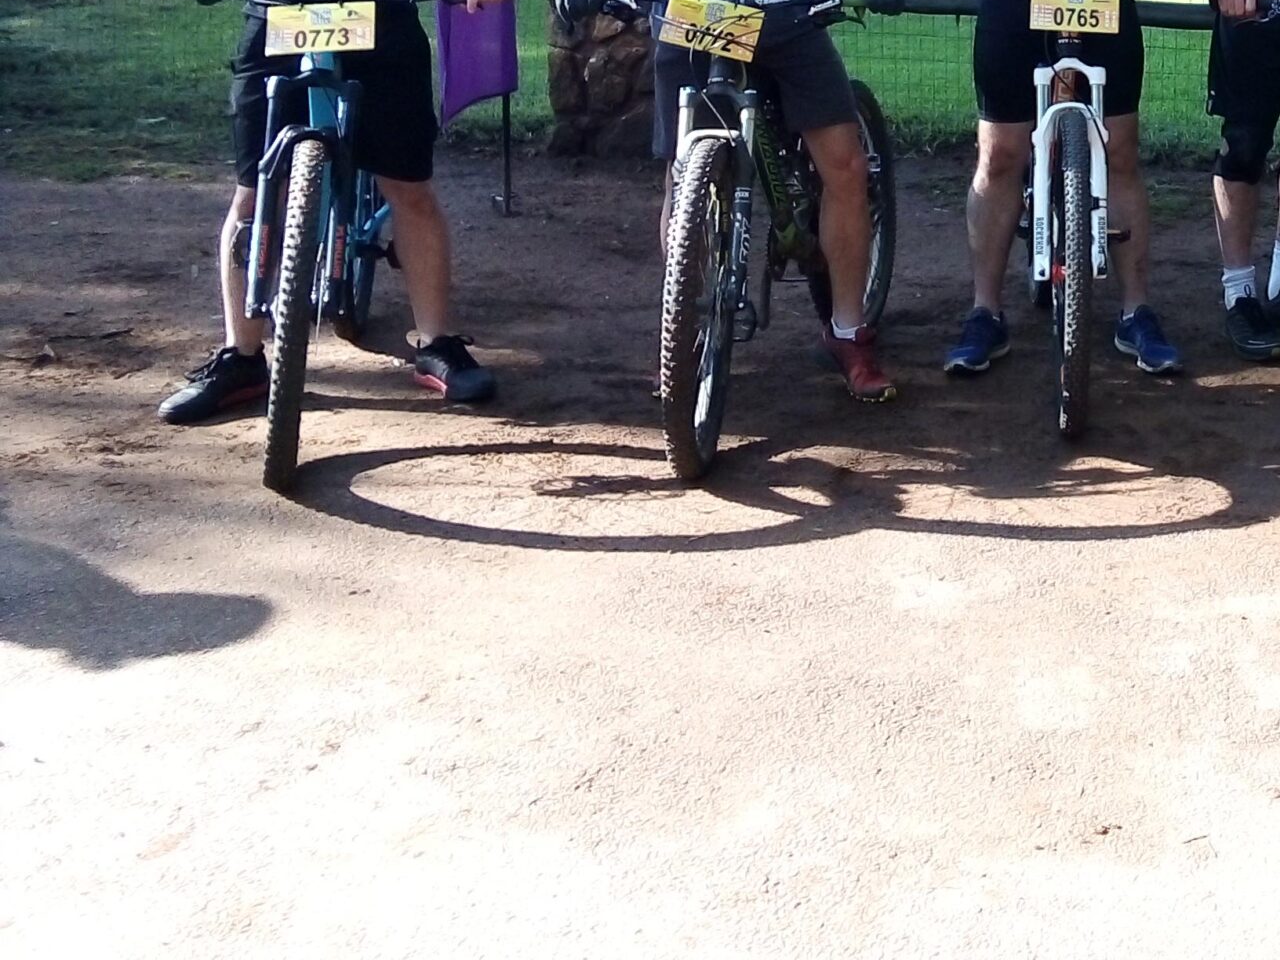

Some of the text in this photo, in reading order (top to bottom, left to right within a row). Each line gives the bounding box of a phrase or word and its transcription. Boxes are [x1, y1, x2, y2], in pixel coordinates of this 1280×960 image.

[1053, 7, 1100, 28] 0765
[294, 27, 350, 49] 0773
[1035, 216, 1045, 255] ROCKSHOX
